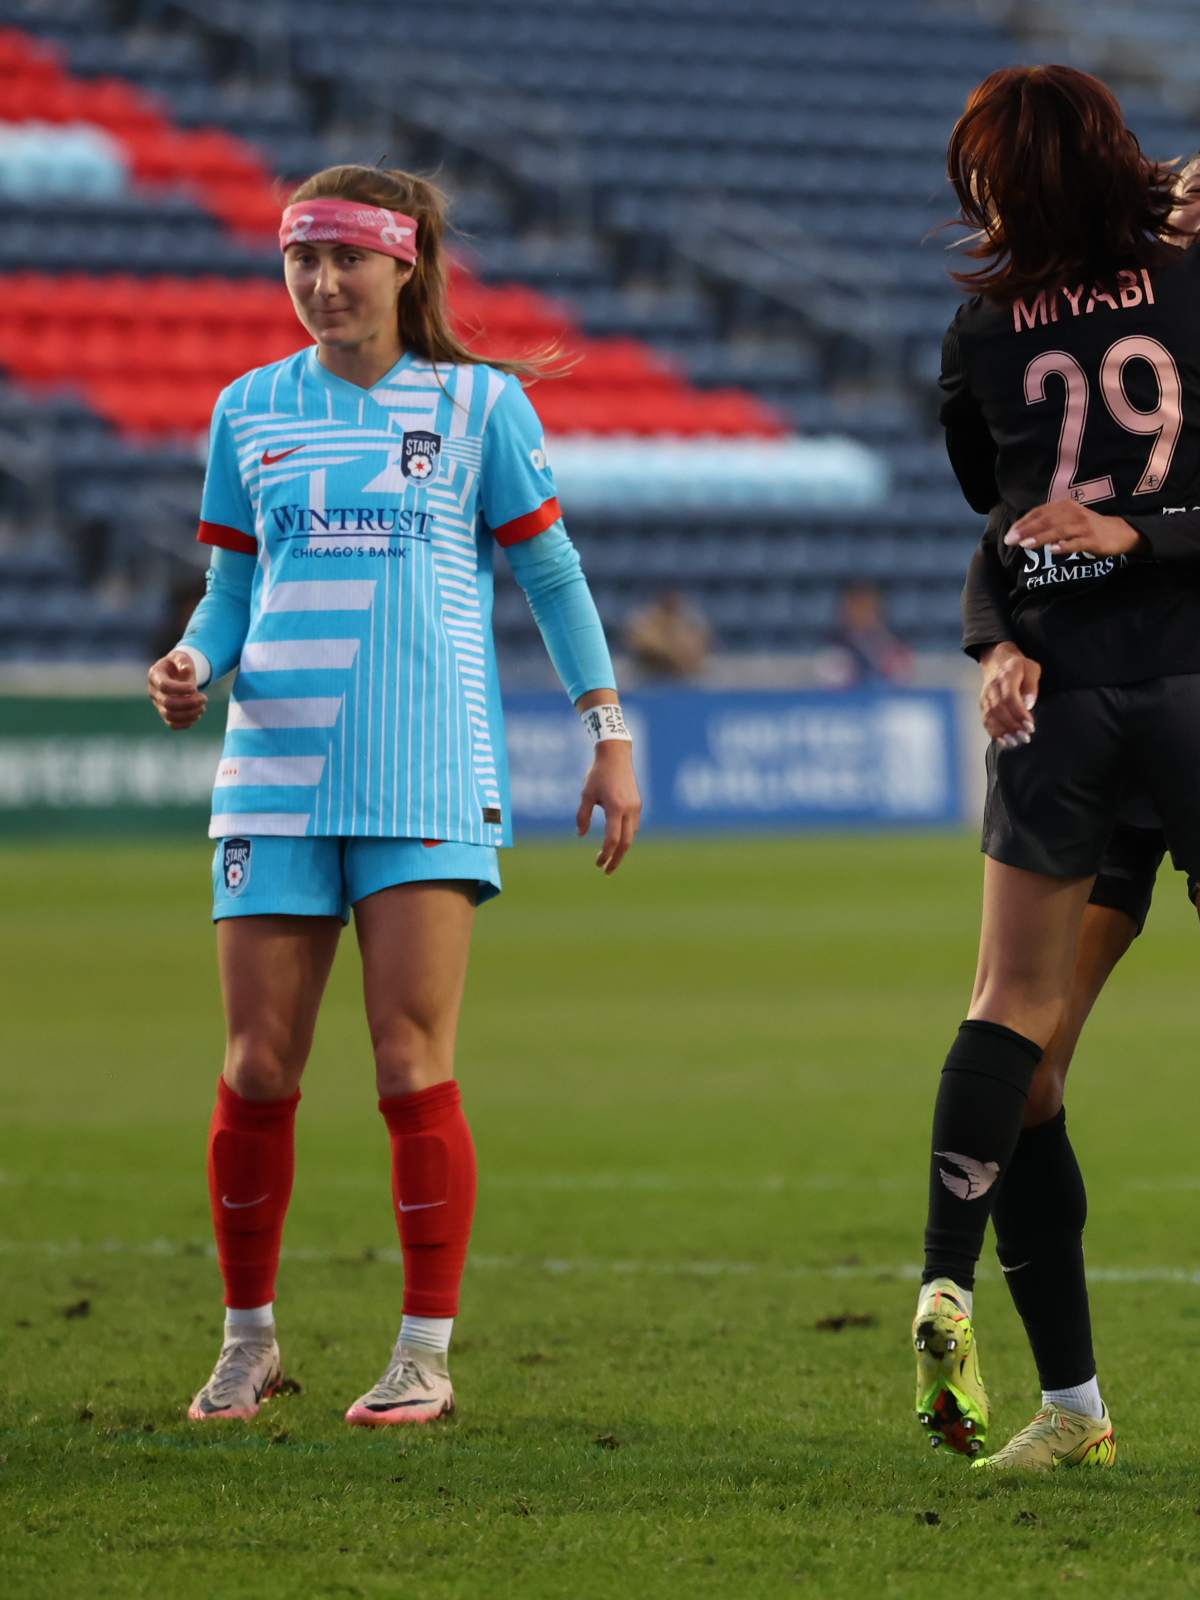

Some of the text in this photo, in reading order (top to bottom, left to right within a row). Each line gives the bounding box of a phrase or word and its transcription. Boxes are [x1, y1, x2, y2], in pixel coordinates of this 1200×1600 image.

[1013, 268, 1155, 333] MIYABI
[1023, 335, 1184, 507] 29
[405, 439, 437, 459] STARS
[271, 504, 434, 535] WINTRUST
[292, 547, 406, 559] CHICAGO'S BANK
[1026, 556, 1114, 590] FARMERS
[602, 706, 618, 733] FUN
[613, 706, 628, 736] HAVE
[225, 848, 248, 866] STARS
